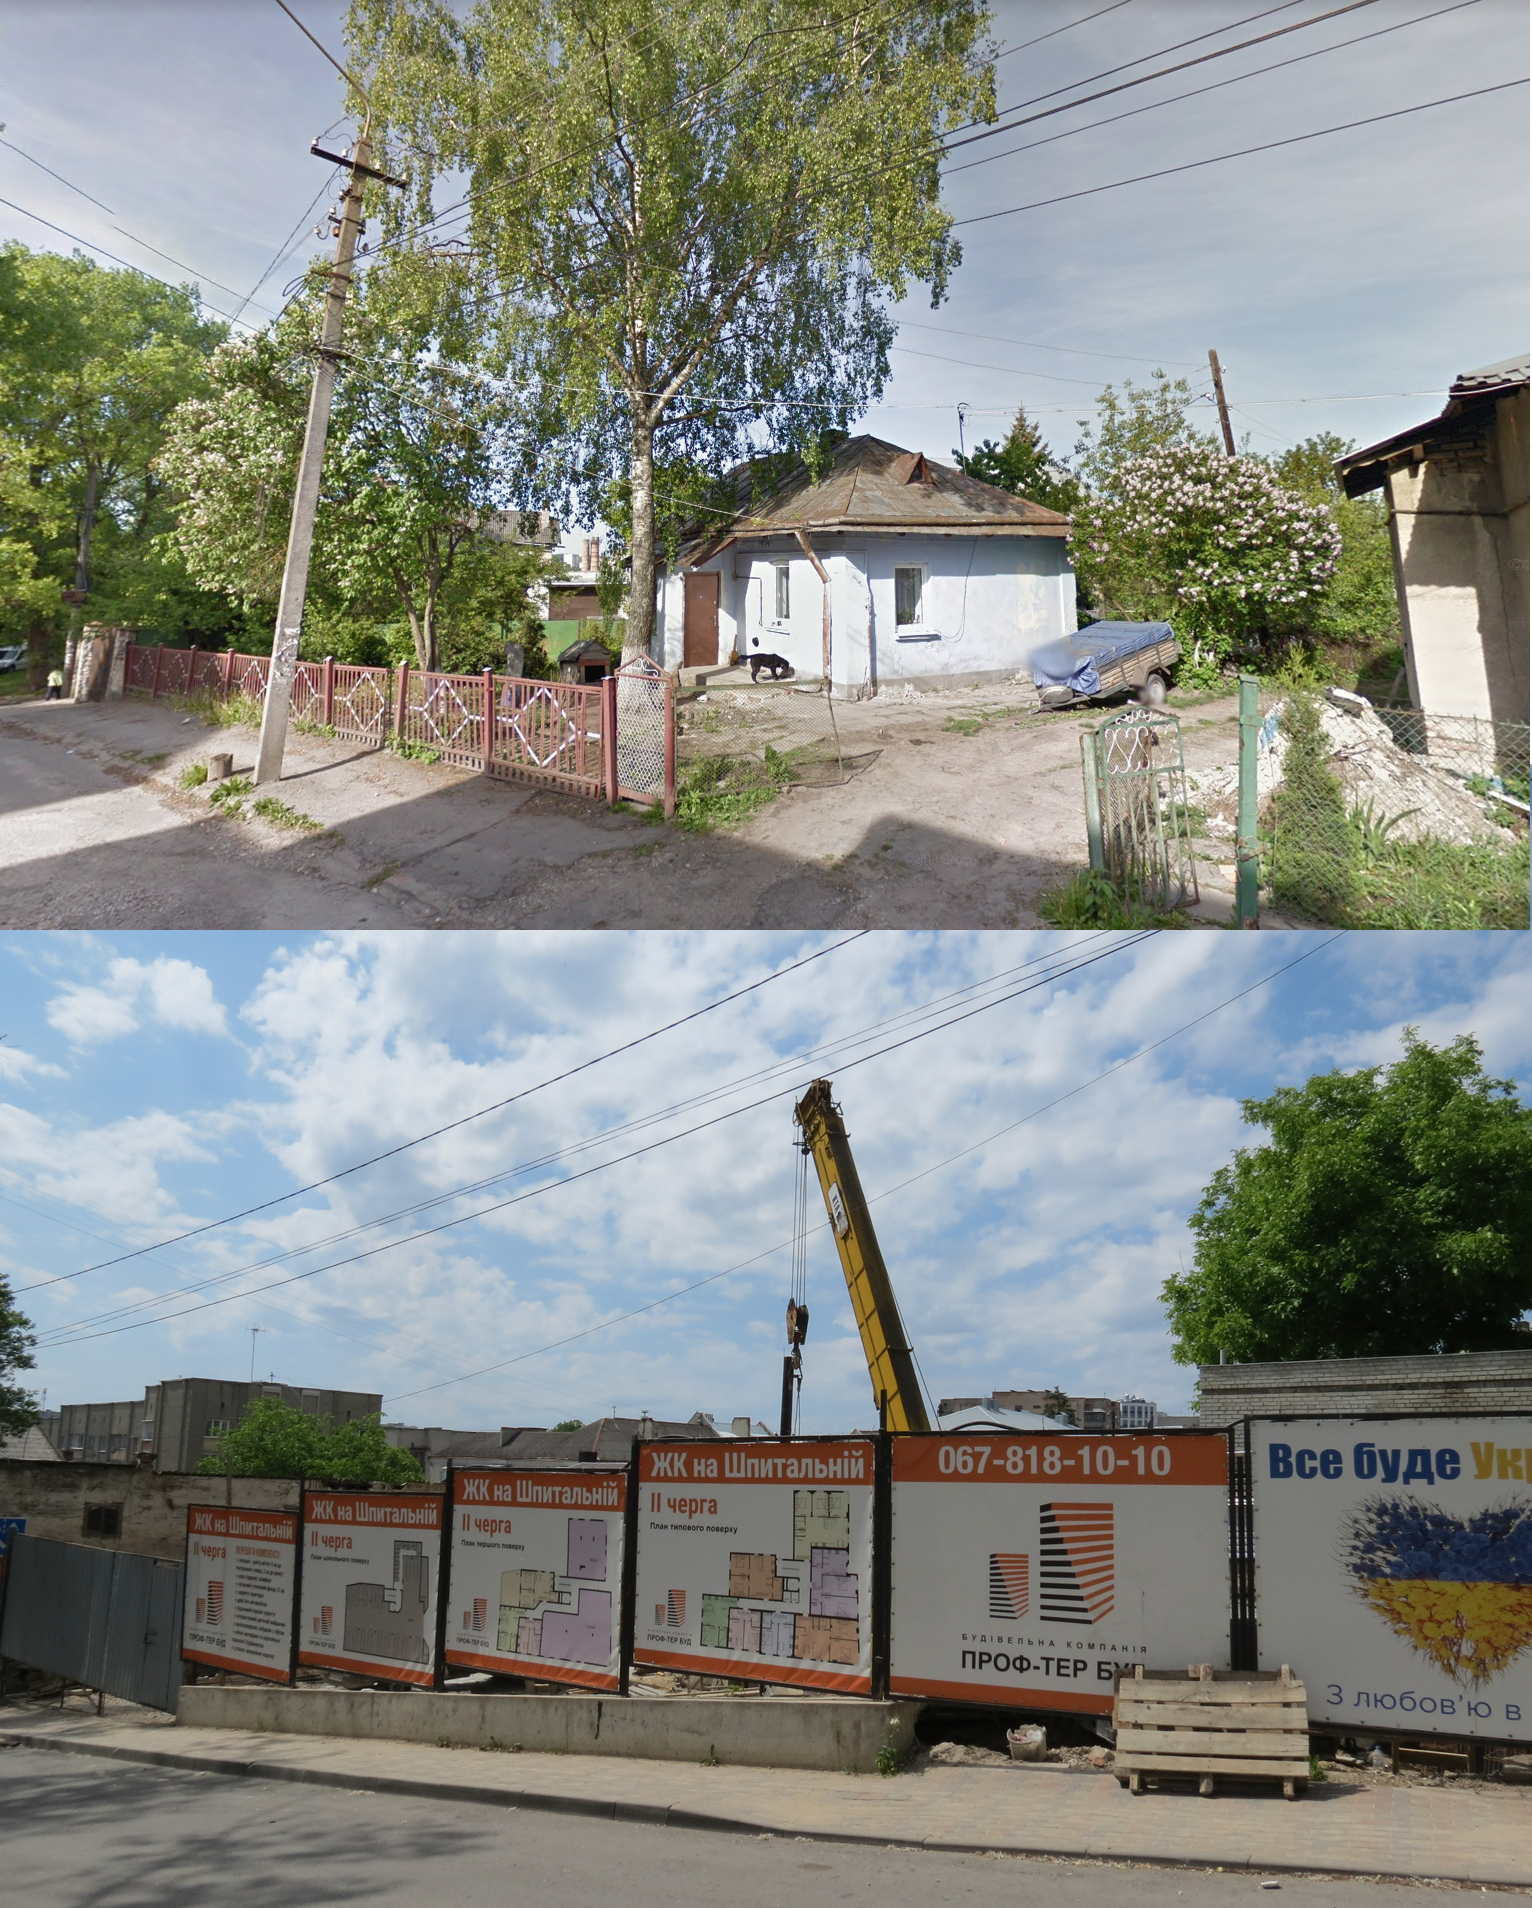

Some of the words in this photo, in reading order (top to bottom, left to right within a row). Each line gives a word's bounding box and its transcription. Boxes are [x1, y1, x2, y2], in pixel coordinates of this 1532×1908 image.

[650, 1452, 688, 1478] ЖК
[693, 1458, 718, 1479] на
[724, 1450, 865, 1480] Шпитальній
[938, 1445, 1172, 1476] 067-818-10-10
[1269, 1443, 1343, 1480] Все
[1353, 1442, 1461, 1486] буде
[462, 1478, 491, 1501] ЖК
[493, 1484, 513, 1502] на
[516, 1480, 619, 1506] Шпитальній
[311, 1500, 335, 1520] ЖК
[337, 1505, 353, 1521] на
[355, 1501, 437, 1525] Шпитальній
[667, 1496, 718, 1520] черга
[194, 1512, 213, 1531] ЖК
[214, 1518, 227, 1533] на
[229, 1515, 293, 1540] Шпитальній
[474, 1518, 512, 1538] черга
[650, 1521, 669, 1531] План
[670, 1523, 705, 1533] типового
[706, 1525, 738, 1535] поверху
[201, 1544, 227, 1561] черга
[322, 1535, 353, 1552] черга
[461, 1539, 475, 1548] План
[476, 1541, 500, 1551] першого
[501, 1543, 525, 1552] поверху
[189, 1633, 216, 1645] ПРОФ-ТЕР
[216, 1638, 227, 1649] БУД
[456, 1637, 480, 1647] ПРОФ-ТЕР
[480, 1641, 490, 1649] БУД
[647, 1633, 678, 1644] ПРОФ-ТЕР
[679, 1637, 692, 1647] БУД
[961, 1632, 1056, 1648] БУДІВЕЛЬНА
[1066, 1640, 1148, 1654] КОМПАНІЯ
[961, 1650, 1089, 1679] ПРОФ-ТЕР
[1326, 1683, 1344, 1705] З
[1506, 1703, 1522, 1721] в
